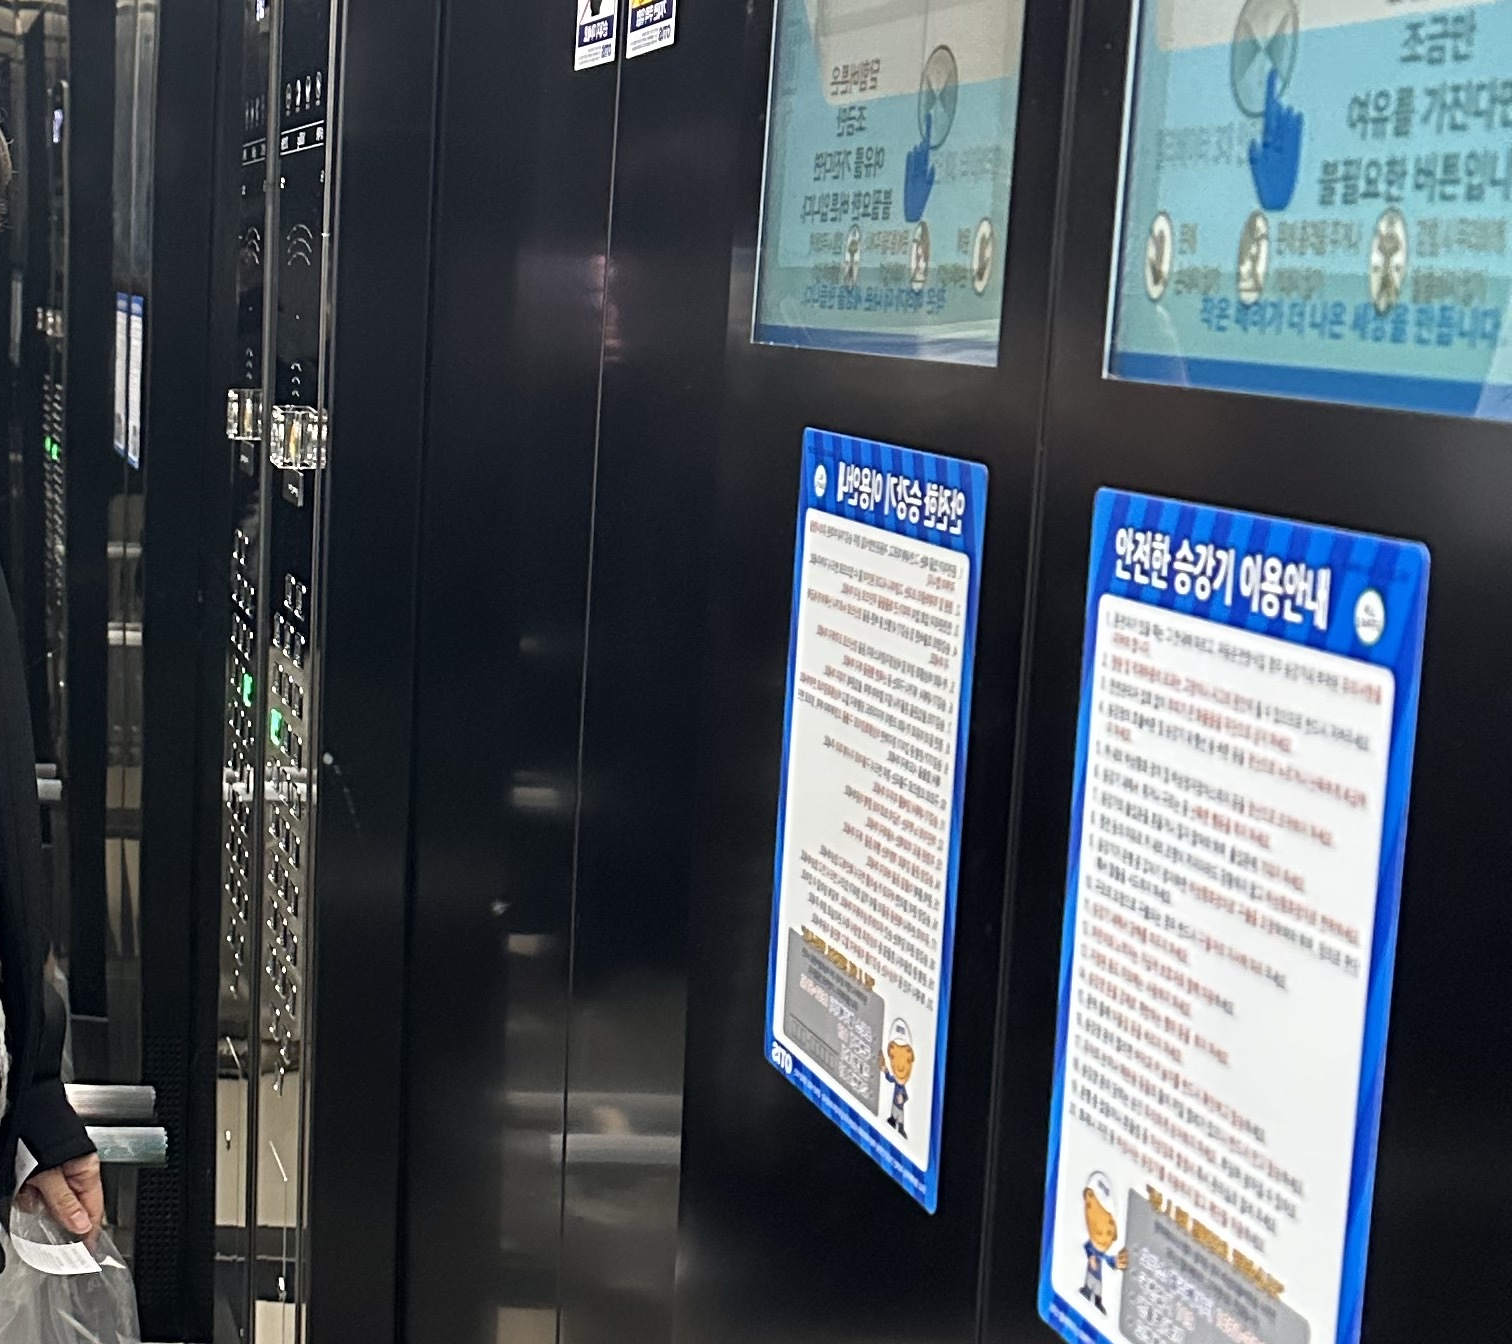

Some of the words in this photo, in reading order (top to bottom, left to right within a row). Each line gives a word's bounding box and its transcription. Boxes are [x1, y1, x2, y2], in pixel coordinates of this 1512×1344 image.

[1400, 9, 1477, 65] 조금만
[1346, 84, 1414, 138] 여유를
[1317, 151, 1407, 205] 불필요한
[1115, 527, 1172, 590] 안전한
[1173, 538, 1234, 606] 승강기
[1239, 553, 1332, 631] 이용안내
